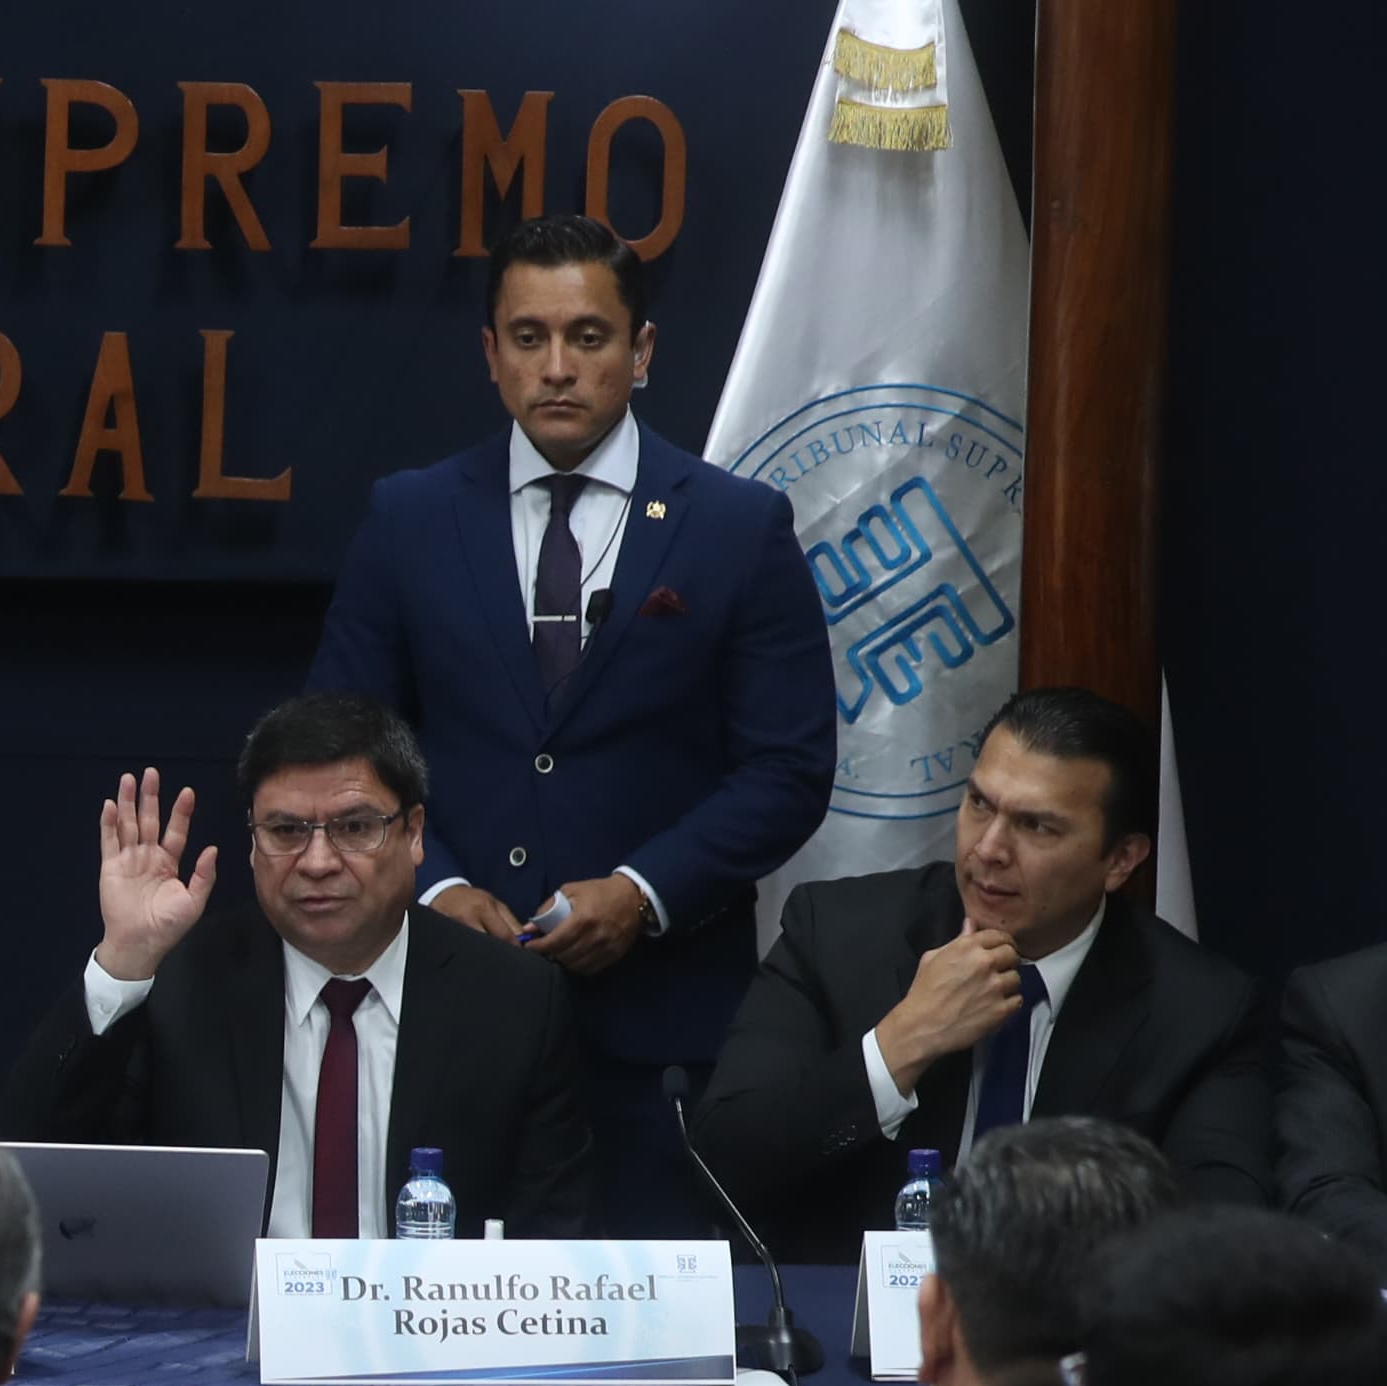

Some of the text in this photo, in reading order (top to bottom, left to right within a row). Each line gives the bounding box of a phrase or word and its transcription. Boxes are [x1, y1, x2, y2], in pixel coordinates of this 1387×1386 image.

[284, 1281, 325, 1293] 2023
[340, 1274, 658, 1301] Dr. Ranulfo Rafael
[393, 1308, 609, 1343] Rojas Cetina
